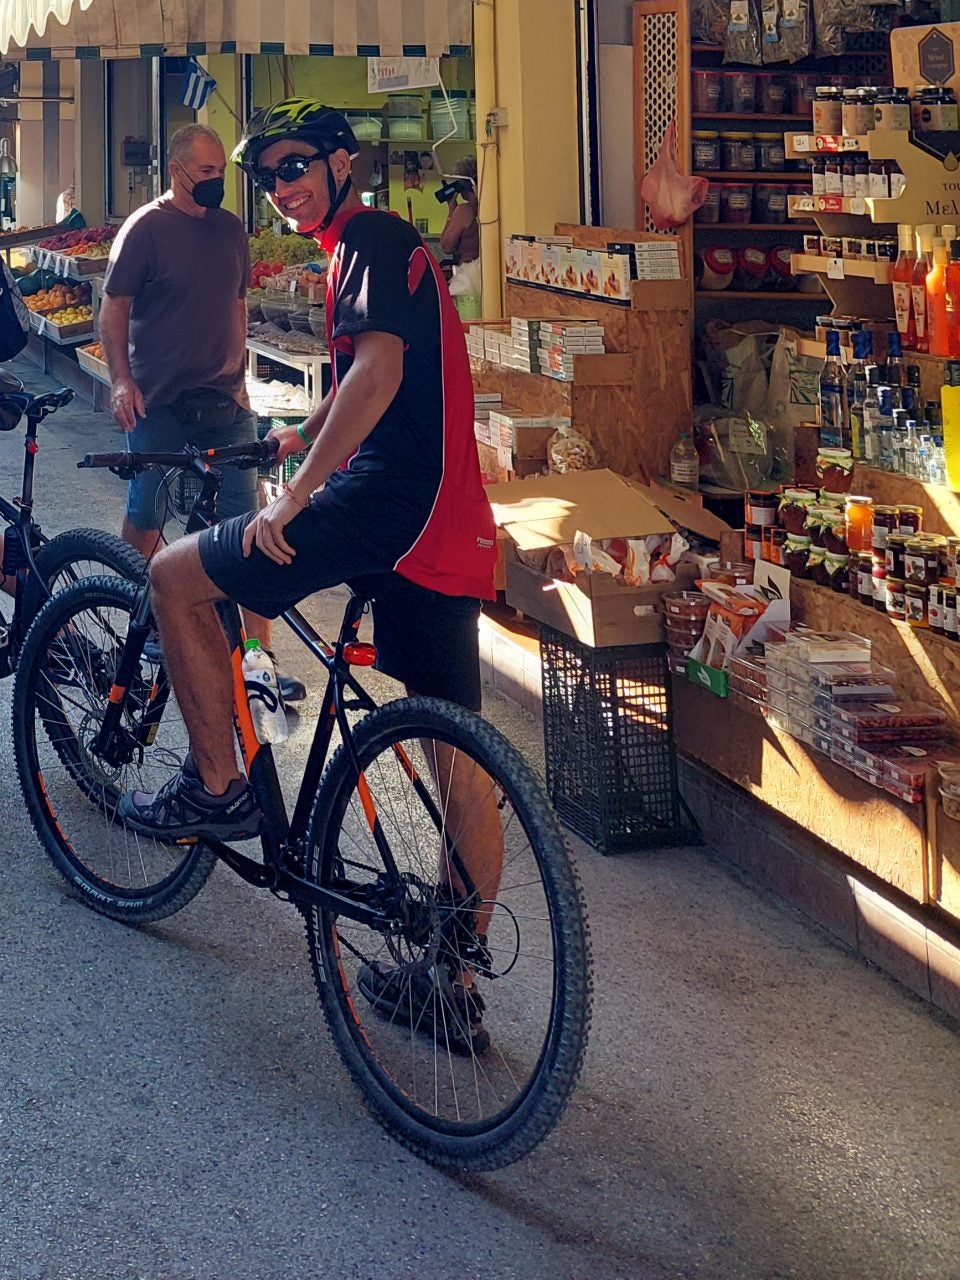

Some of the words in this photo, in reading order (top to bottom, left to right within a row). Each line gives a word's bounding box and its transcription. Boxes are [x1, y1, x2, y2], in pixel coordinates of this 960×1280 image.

[225, 791, 250, 815] salomon
[73, 875, 114, 904] SMART
[117, 900, 144, 908] SAM
[311, 844, 327, 983] SCHWBE
